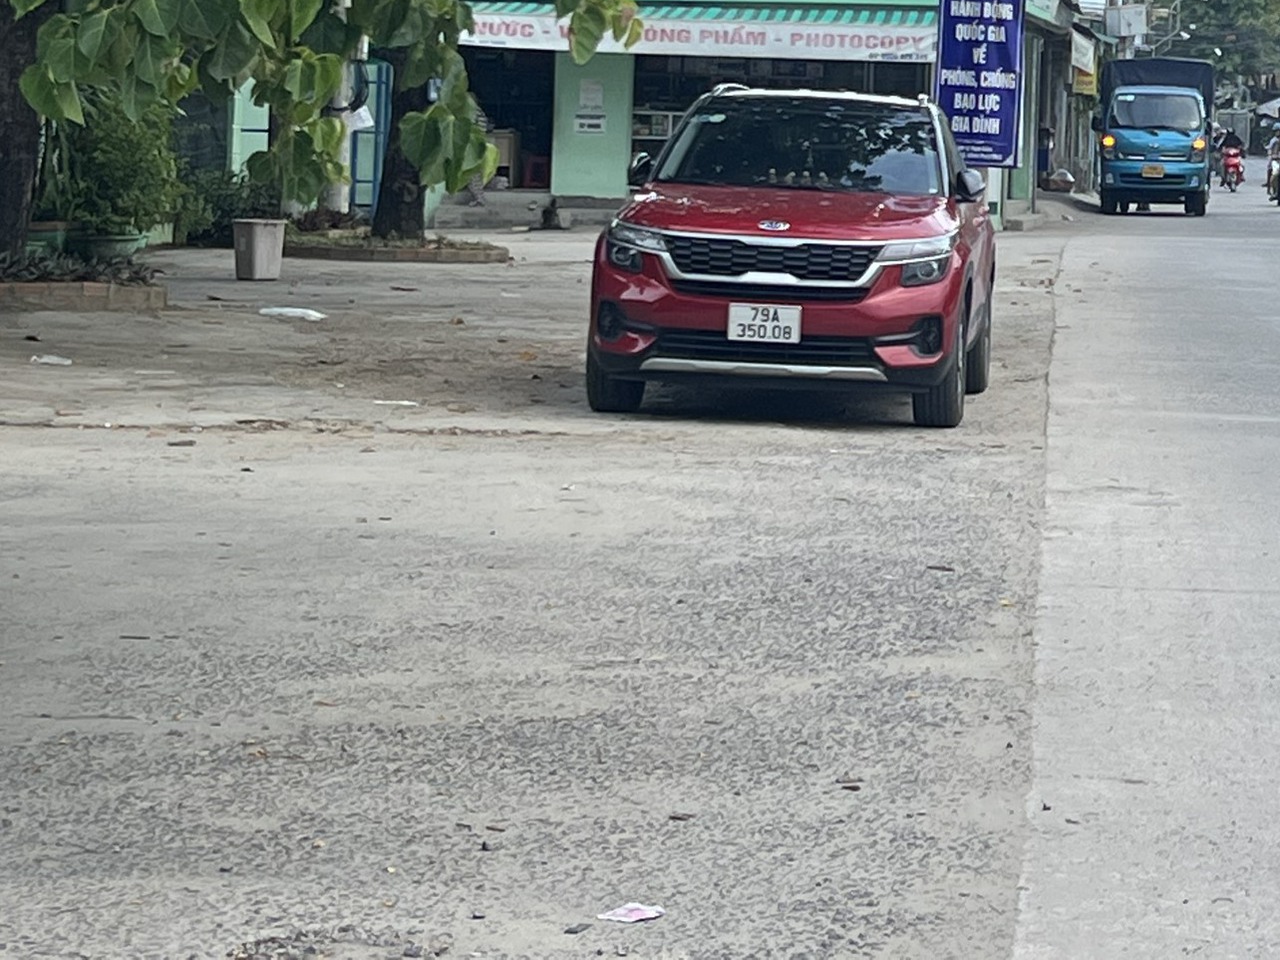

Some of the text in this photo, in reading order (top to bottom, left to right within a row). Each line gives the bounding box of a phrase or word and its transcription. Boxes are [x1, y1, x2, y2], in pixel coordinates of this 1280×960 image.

[983, 0, 1014, 22] ĐỘNG
[644, 25, 691, 43] ÒNG
[790, 32, 925, 50] PHOTOCOPY
[956, 19, 1006, 43] QUỐC GIA
[980, 66, 1016, 90] CHỐNG
[954, 93, 1000, 115] BẠO LỰC
[951, 114, 1000, 135] GIA ĐÌNH
[751, 307, 780, 322] 79A
[737, 323, 792, 340] 350.08
